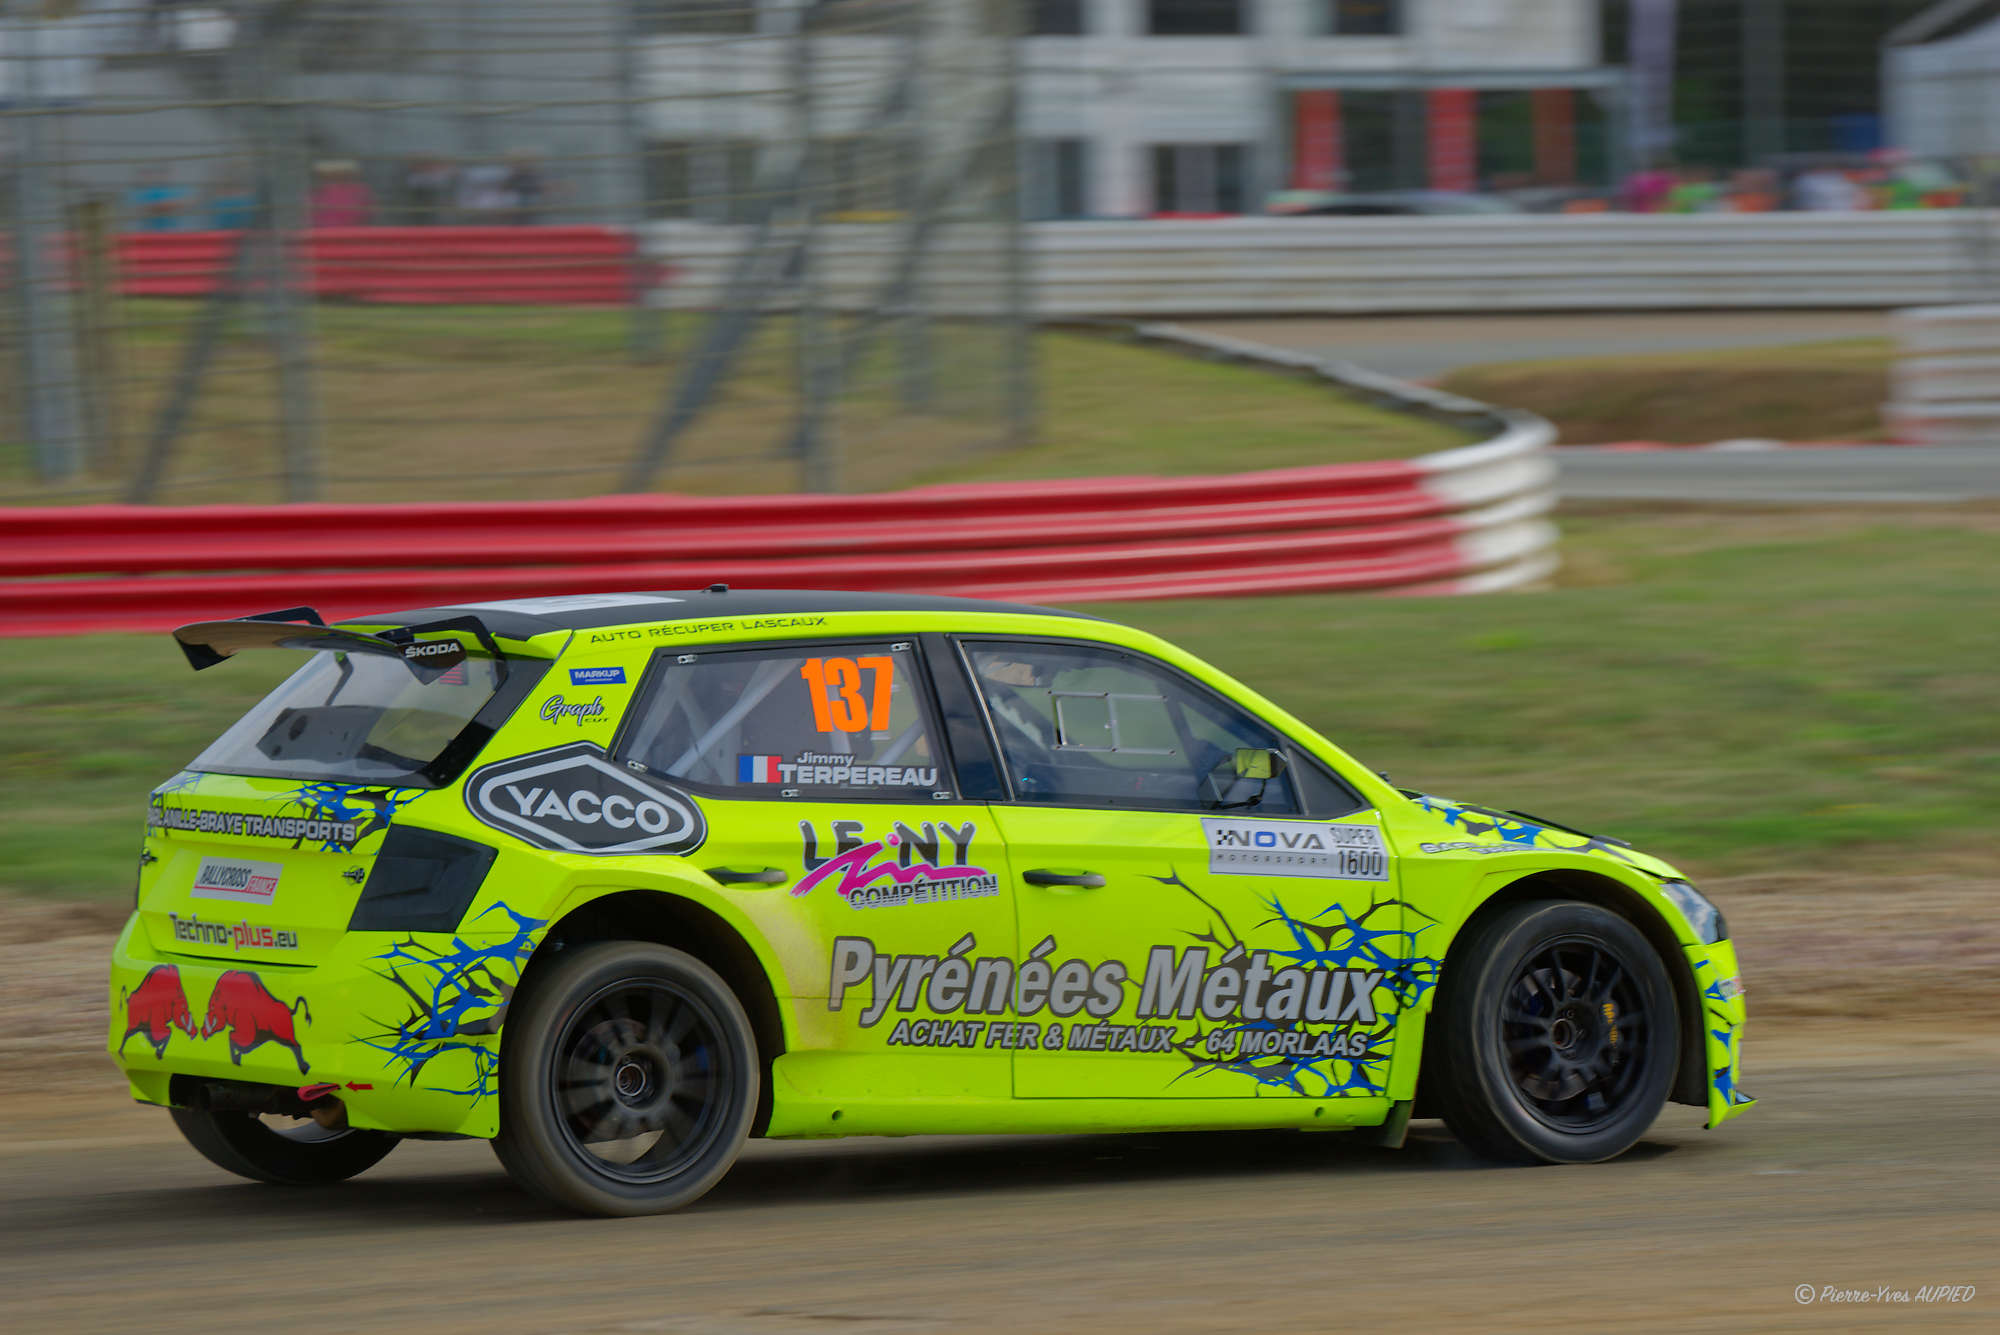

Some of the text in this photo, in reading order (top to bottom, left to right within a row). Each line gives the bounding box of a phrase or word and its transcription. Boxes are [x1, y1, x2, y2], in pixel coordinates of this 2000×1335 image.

[590, 616, 827, 644] AUTO RÉCUPER LASCAUX
[404, 641, 461, 659] ŠKODA
[574, 669, 621, 679] MARKUP
[801, 655, 893, 733] 137
[539, 694, 605, 727] Graph
[796, 752, 855, 769] Jimmy
[777, 763, 938, 788] TERPEREAU
[504, 784, 670, 833] YACCO
[244, 816, 357, 843] TRANSPORTS
[1227, 830, 1326, 850] NOVA
[199, 863, 254, 890] RALLYCROSS
[1337, 850, 1383, 877] 1600
[849, 873, 999, 910] COMPÉTITION
[168, 911, 299, 953] Techno-plus.eu
[827, 931, 1385, 1029] Pyrénées Métaux
[888, 1018, 978, 1048] ACHAT
[986, 1022, 1037, 1048] FER
[1042, 1027, 1065, 1051] &
[1068, 1020, 1176, 1054] MÉTAUX
[1206, 1030, 1238, 1057] 64
[1239, 1030, 1369, 1059] MORLAAS
